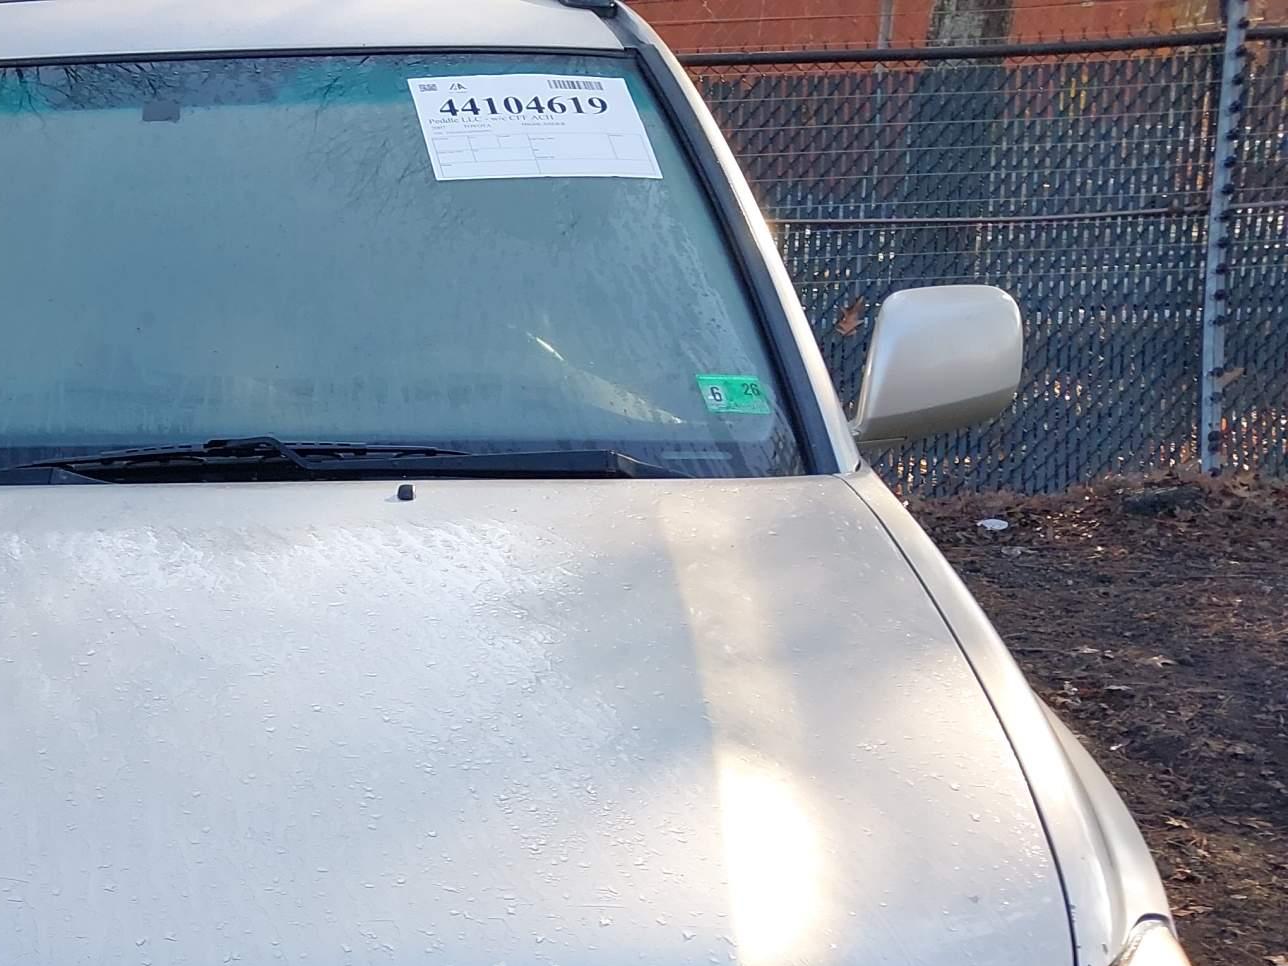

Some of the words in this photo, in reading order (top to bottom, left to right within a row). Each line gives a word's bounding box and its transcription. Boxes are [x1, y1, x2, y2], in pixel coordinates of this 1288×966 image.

[439, 95, 608, 117] 44104619
[429, 117, 460, 126] Peddle
[462, 115, 482, 124] LLC
[710, 386, 722, 402] 6
[742, 382, 761, 396] 26
